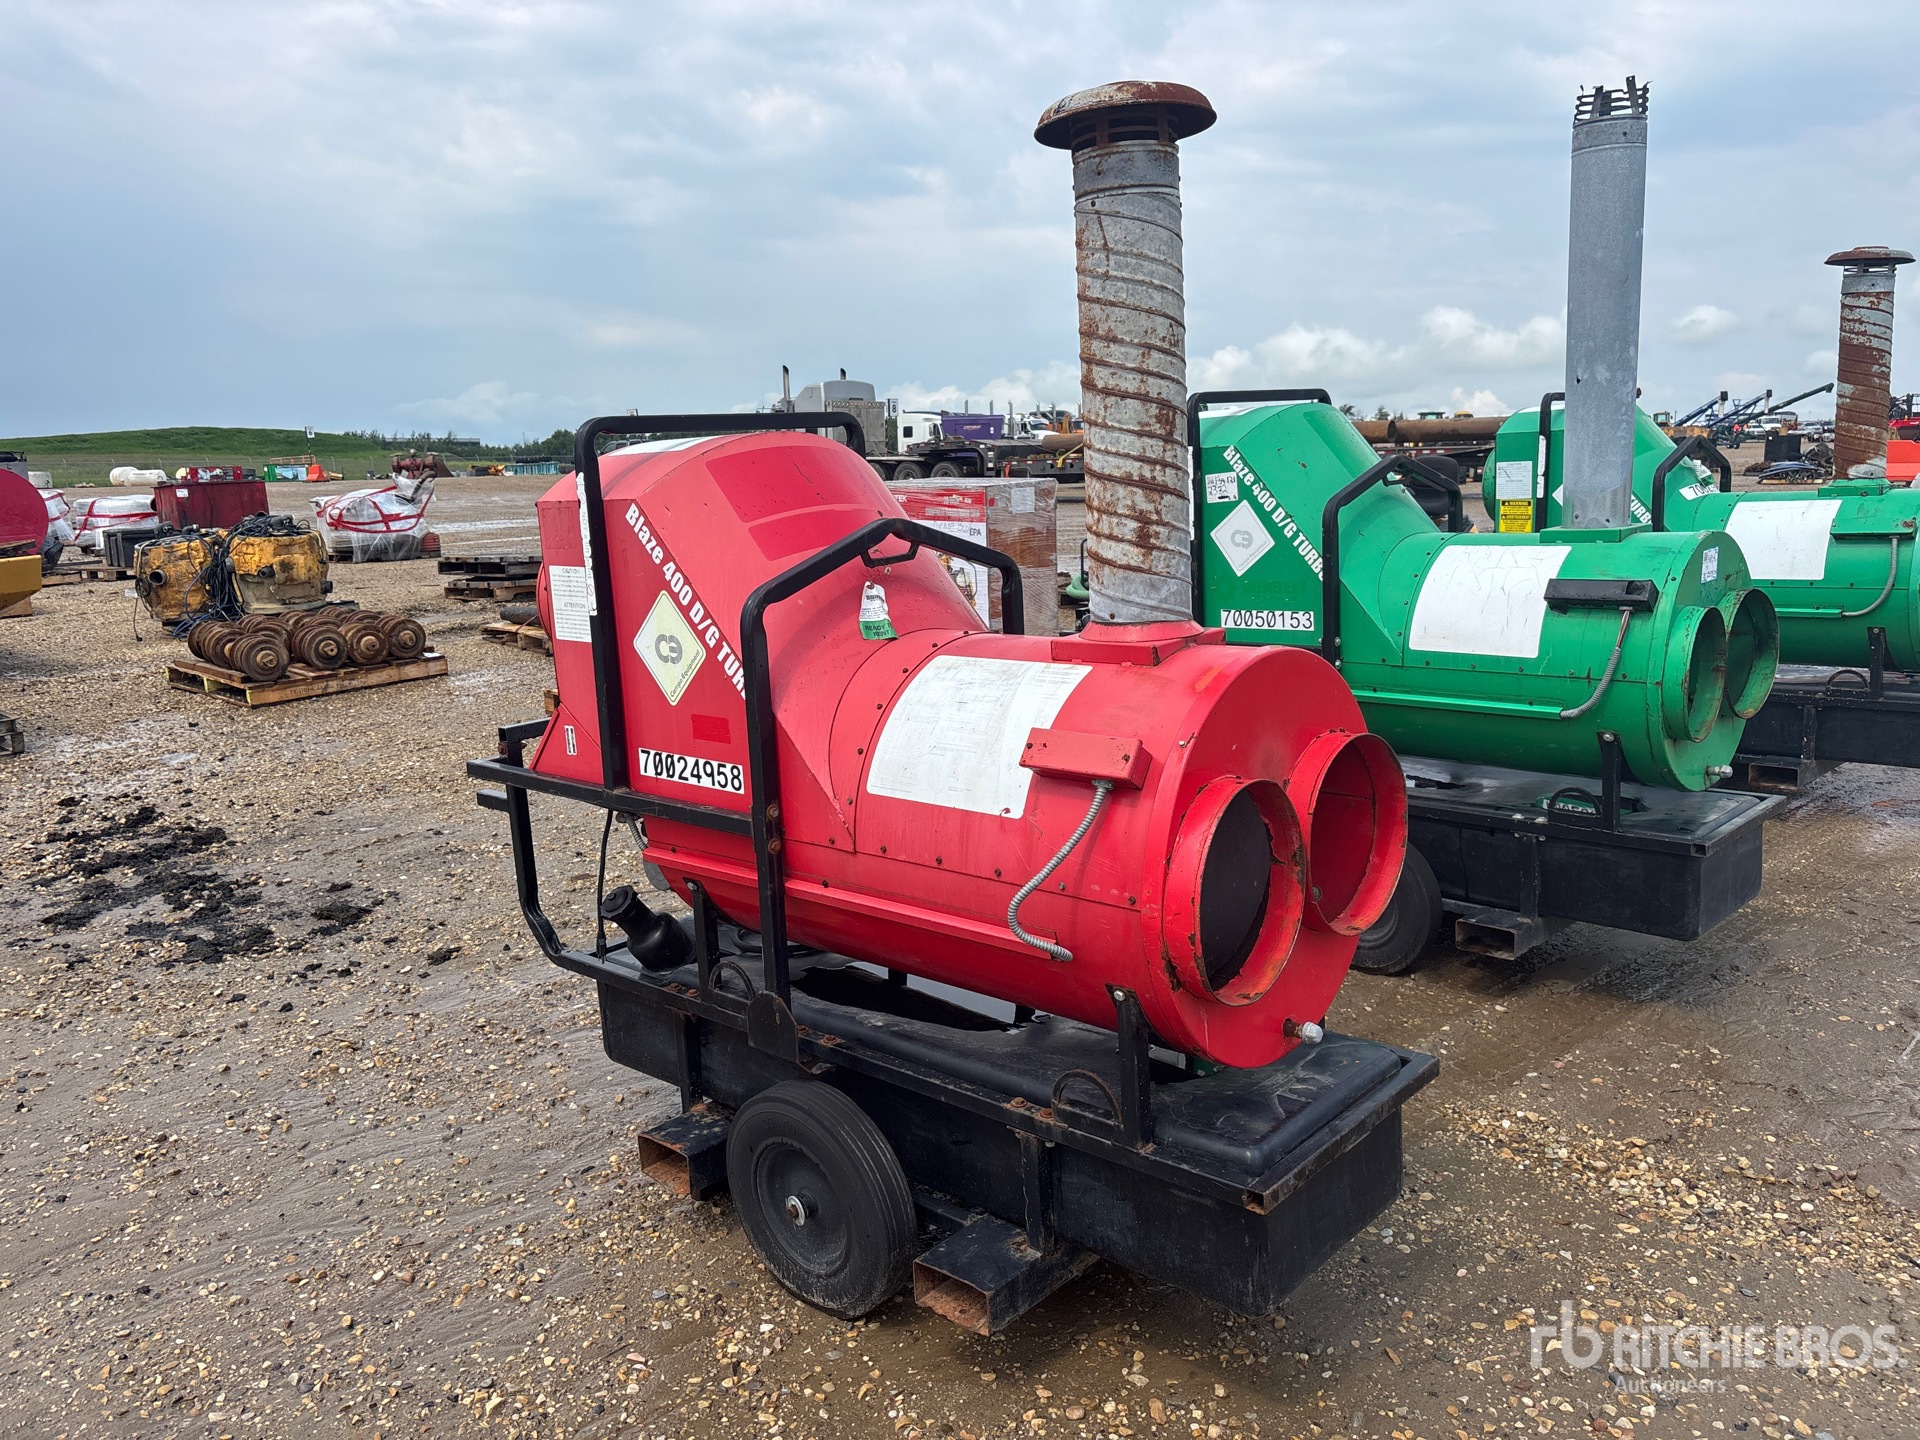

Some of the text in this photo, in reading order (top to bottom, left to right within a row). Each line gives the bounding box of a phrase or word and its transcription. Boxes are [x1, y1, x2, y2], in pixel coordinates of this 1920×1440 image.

[891, 404, 897, 413] 8
[1222, 445, 1255, 486] Blaze
[1251, 482, 1277, 512] 400
[1271, 510, 1298, 539] D/G
[969, 529, 982, 537] EPA
[563, 601, 586, 609] ATTENTION
[625, 502, 746, 701] Blaze 400 D/G TUR
[1222, 609, 1313, 629] 70050153
[669, 649, 701, 698] Campo Equipment
[640, 749, 743, 792] 70024958
